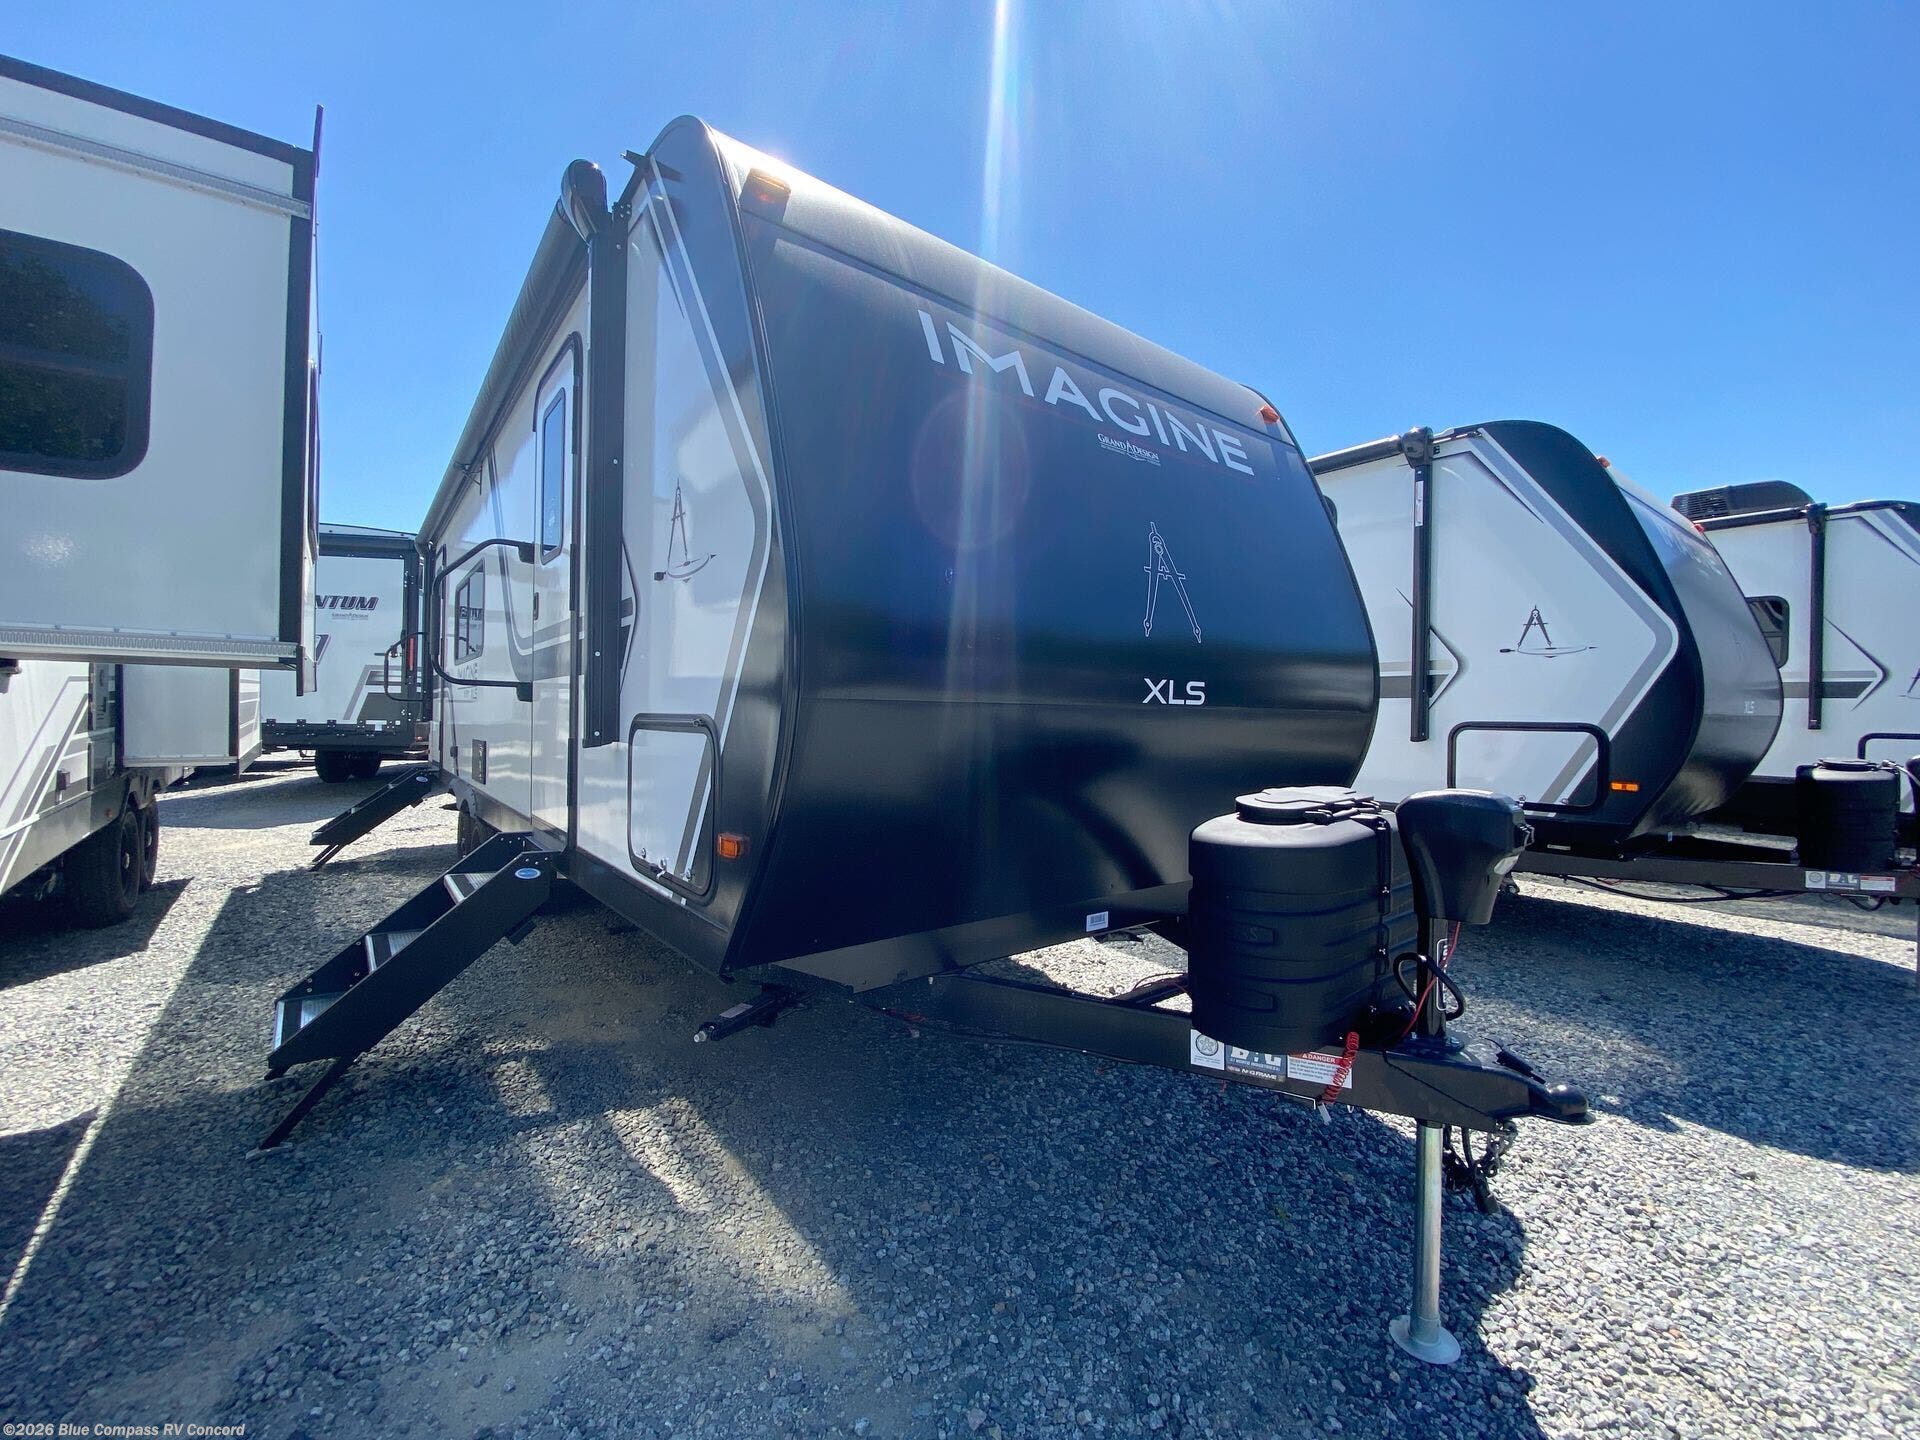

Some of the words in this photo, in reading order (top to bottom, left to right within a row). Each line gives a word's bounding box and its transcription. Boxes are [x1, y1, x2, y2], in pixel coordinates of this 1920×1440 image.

[917, 309, 1255, 477] IMAGINE
[1097, 433, 1127, 451] GRAND
[1142, 677, 1206, 706] XLS
[1308, 1053, 1336, 1064] DANGER
